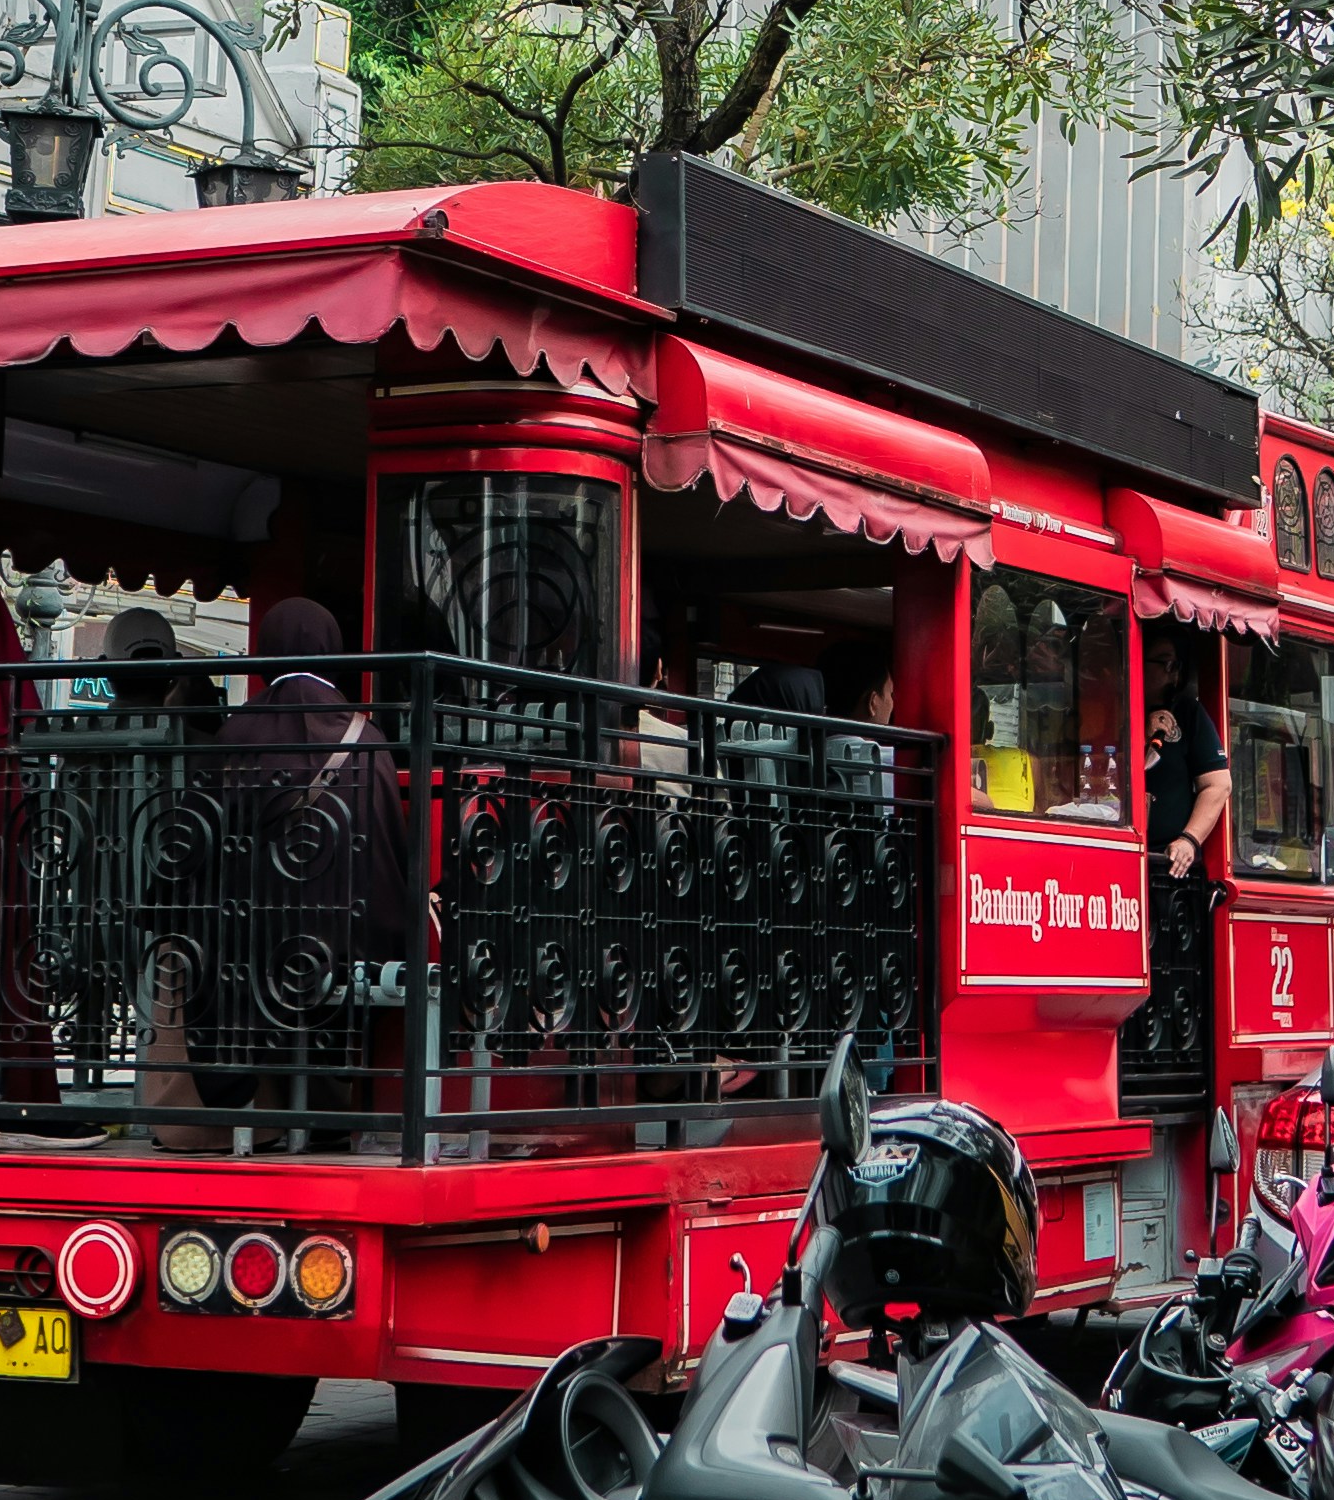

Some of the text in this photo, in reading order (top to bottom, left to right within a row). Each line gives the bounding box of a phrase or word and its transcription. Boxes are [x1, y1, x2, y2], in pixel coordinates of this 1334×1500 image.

[969, 873, 1141, 943] Bandung Tour on Bus
[1271, 945, 1295, 1007] 22
[33, 1316, 70, 1355] AQ
